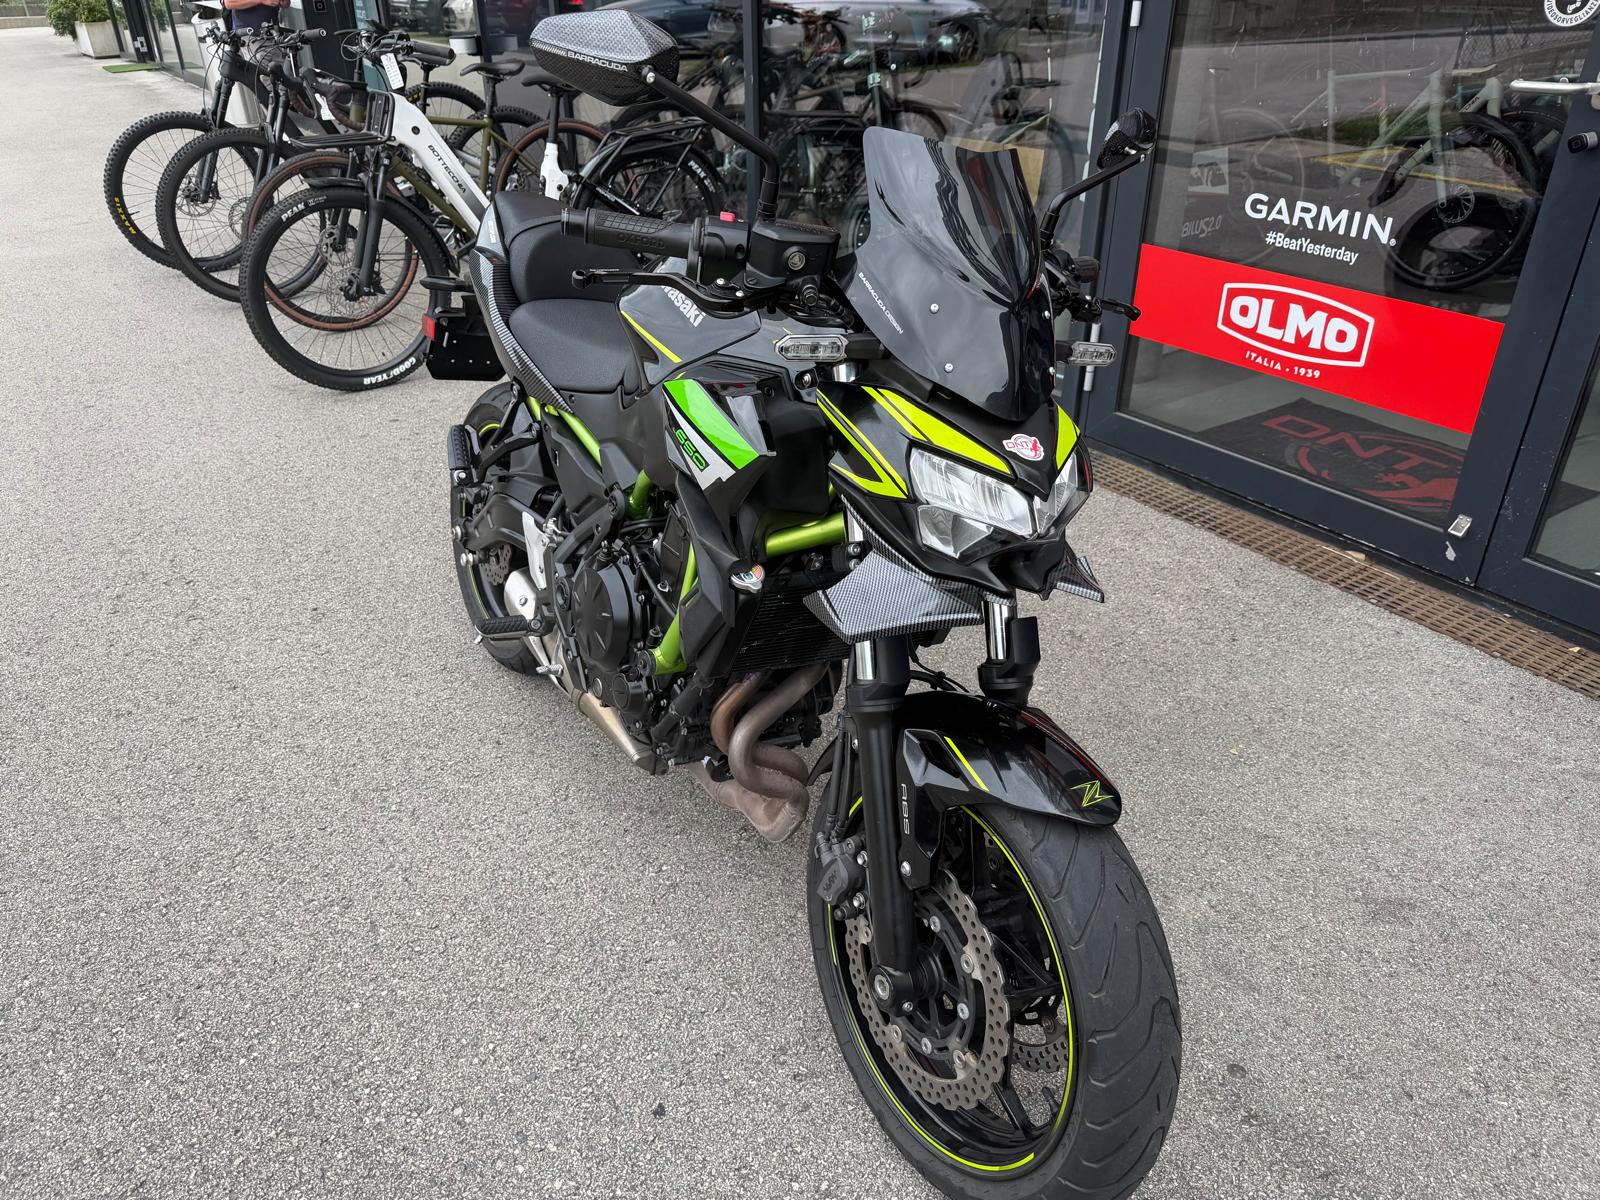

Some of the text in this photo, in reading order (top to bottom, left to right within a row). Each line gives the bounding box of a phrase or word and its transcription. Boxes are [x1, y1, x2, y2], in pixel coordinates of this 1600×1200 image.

[1546, 0, 1598, 24] VIDEOSORVEGLIANZ
[567, 51, 628, 72] BARRACUDA
[428, 144, 466, 193] BOTTECCHIA
[114, 196, 137, 234] MAXXIS
[281, 202, 306, 222] PEAK
[617, 232, 665, 249] OXFORD
[1265, 230, 1358, 265] #BeatYesterday
[660, 285, 706, 327] asaki
[858, 272, 886, 312] BARRACUDA
[1229, 295, 1359, 353] OLMO
[363, 357, 416, 385] GOODYEAR
[1245, 350, 1320, 378] ITALIA 1939
[675, 428, 706, 470] 650
[1005, 440, 1029, 449] DNT
[900, 783, 910, 834] ABS
